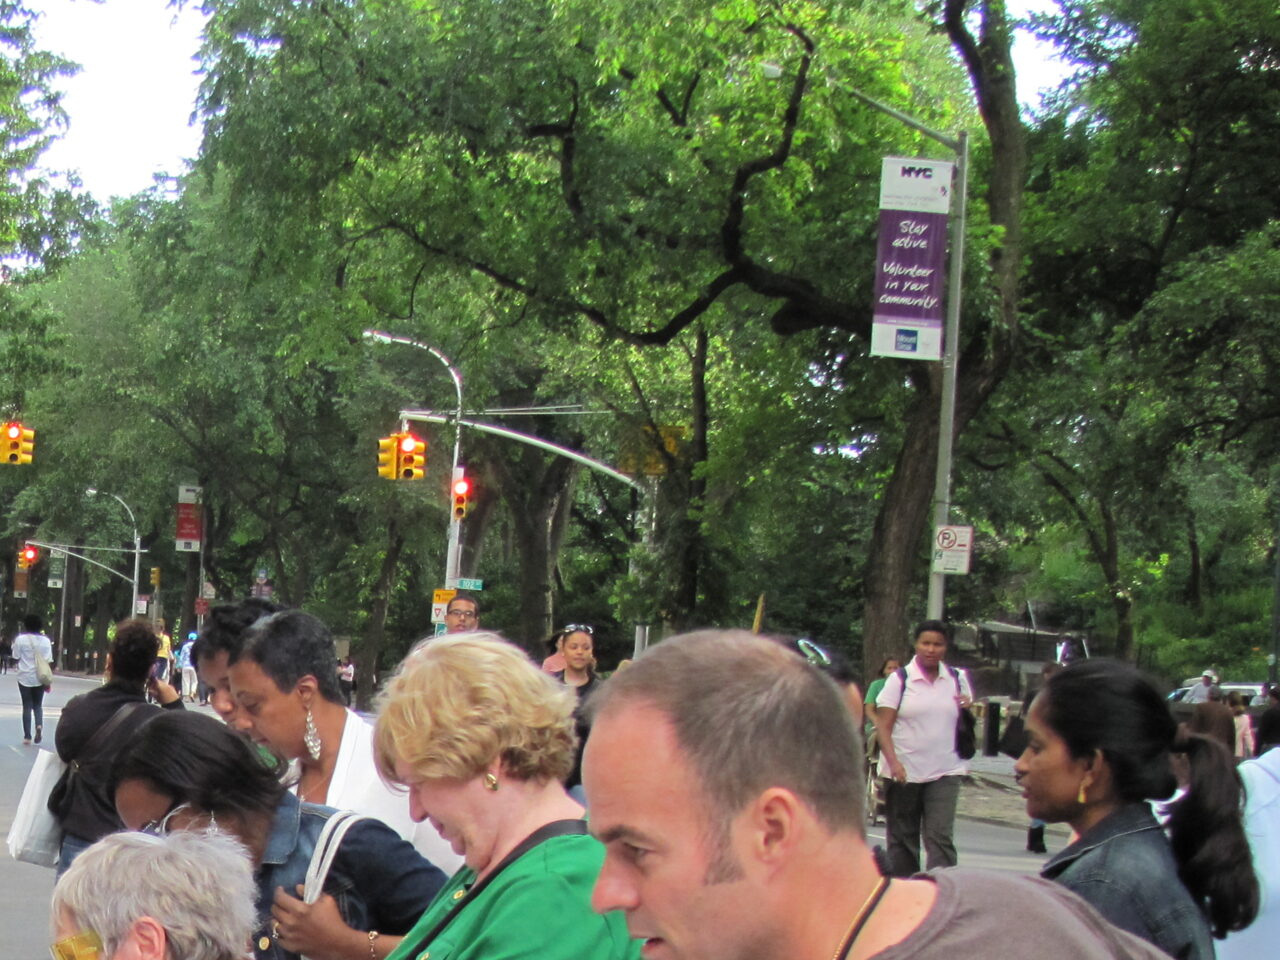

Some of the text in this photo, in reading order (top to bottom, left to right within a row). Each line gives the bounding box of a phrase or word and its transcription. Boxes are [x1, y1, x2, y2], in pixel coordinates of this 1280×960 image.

[900, 166, 933, 179] NYC
[899, 220, 929, 236] Stay
[891, 235, 928, 249] active
[882, 261, 934, 278] Volunteer
[885, 276, 899, 289] in
